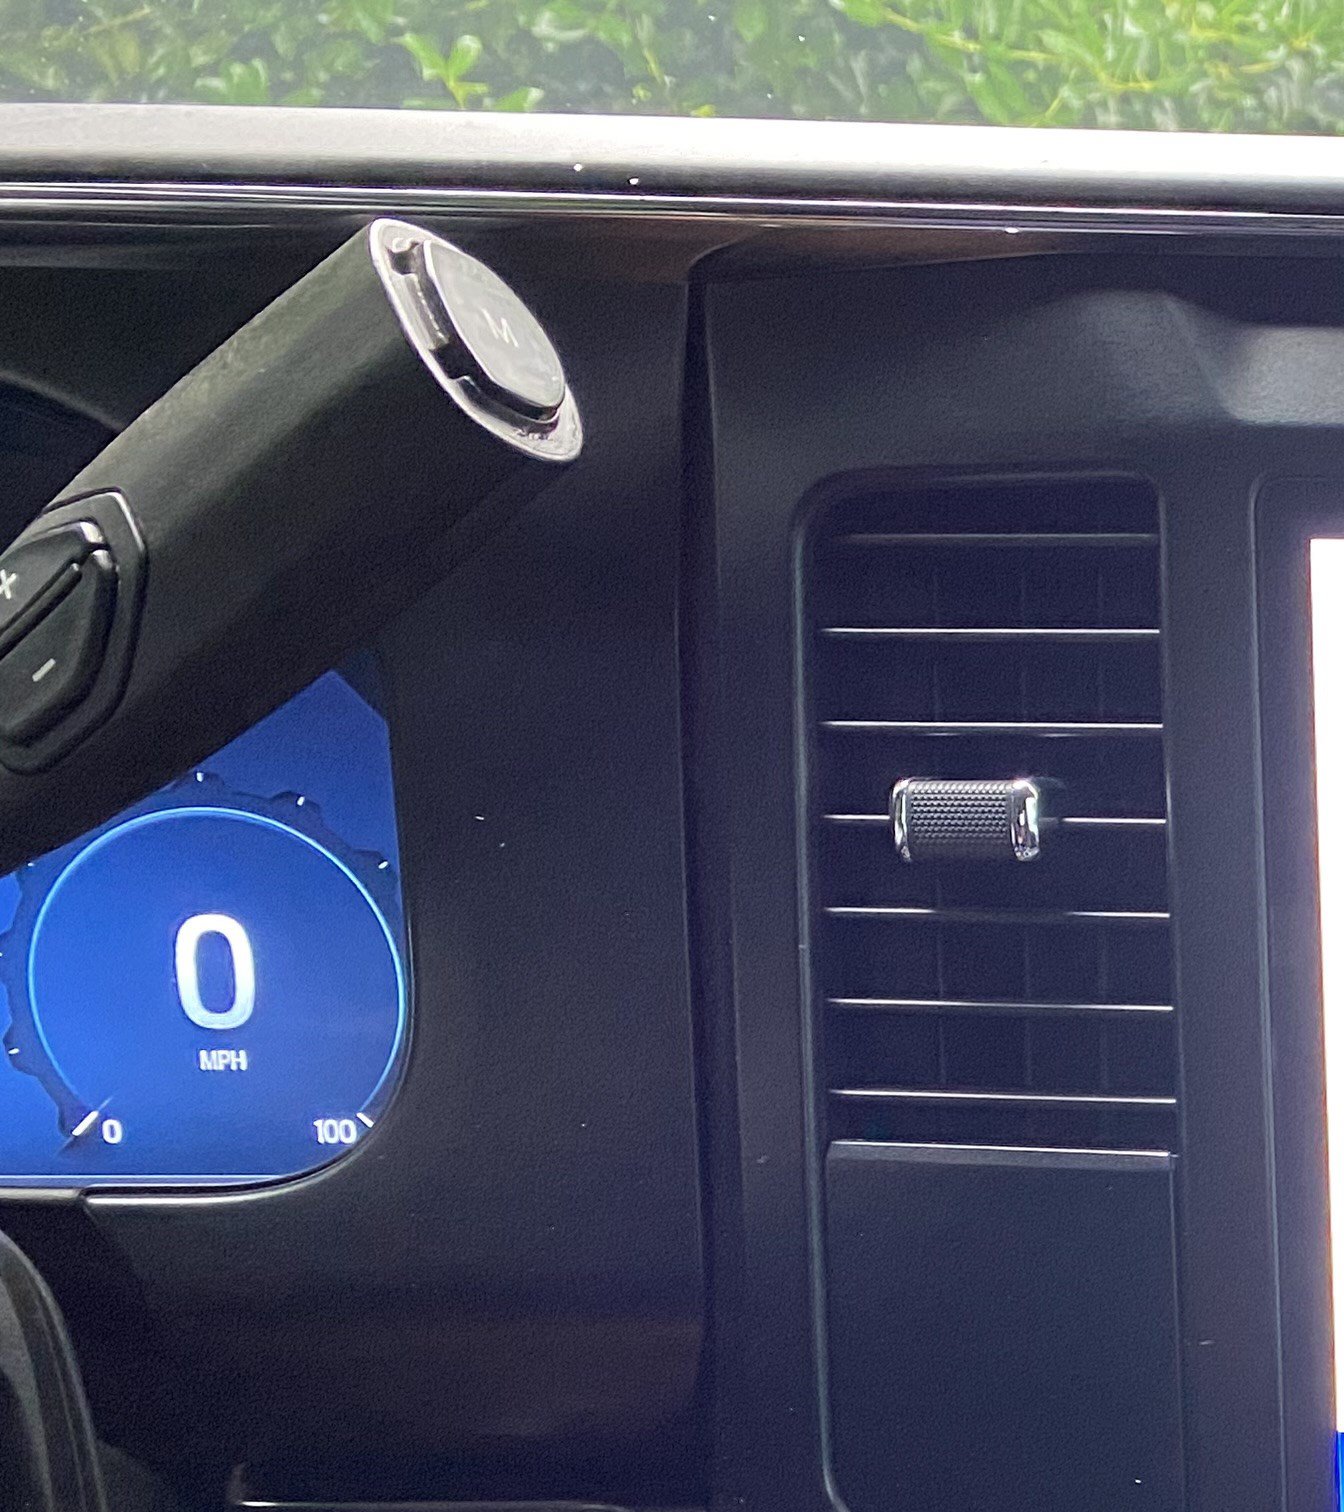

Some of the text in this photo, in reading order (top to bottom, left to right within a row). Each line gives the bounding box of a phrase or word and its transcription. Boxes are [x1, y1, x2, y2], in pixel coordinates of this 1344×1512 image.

[175, 913, 256, 1030] 0
[199, 1049, 248, 1071] MPH
[102, 1118, 123, 1144] 0
[313, 1119, 358, 1144] 100
